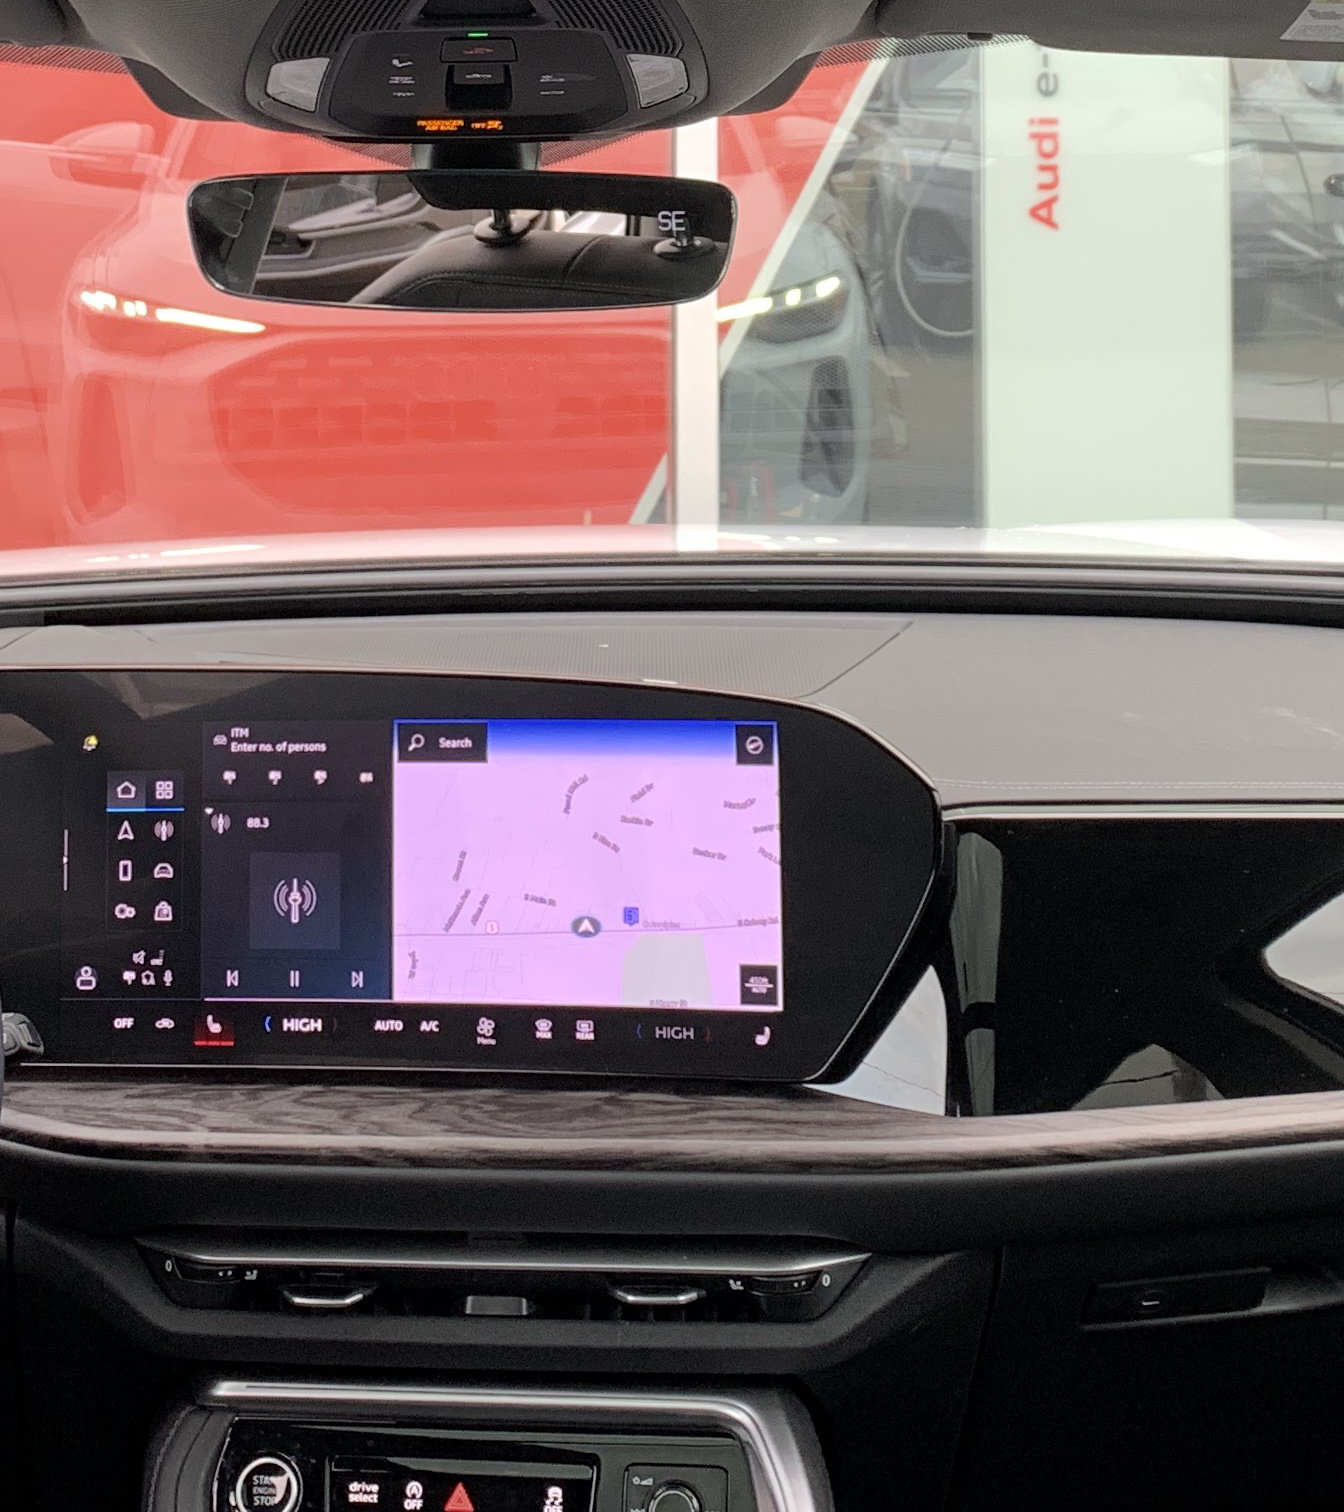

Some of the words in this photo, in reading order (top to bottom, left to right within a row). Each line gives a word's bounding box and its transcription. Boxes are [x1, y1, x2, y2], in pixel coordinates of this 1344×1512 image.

[1028, 117, 1060, 232] Audi
[658, 210, 687, 232] SE
[230, 741, 258, 753] Enter
[258, 743, 274, 753] no.
[276, 741, 287, 753] of
[287, 743, 327, 754] persons
[438, 737, 473, 749] Search
[246, 817, 270, 829] 88.3
[113, 1017, 134, 1029] OFF
[282, 1017, 323, 1032] HIGH
[374, 1019, 404, 1032] AUTO
[419, 1019, 440, 1032] A/C
[575, 1031, 595, 1041] REAR
[655, 1026, 695, 1040] HIGH
[348, 1481, 380, 1493] drive
[348, 1493, 379, 1503] select
[403, 1500, 423, 1511] OFF
